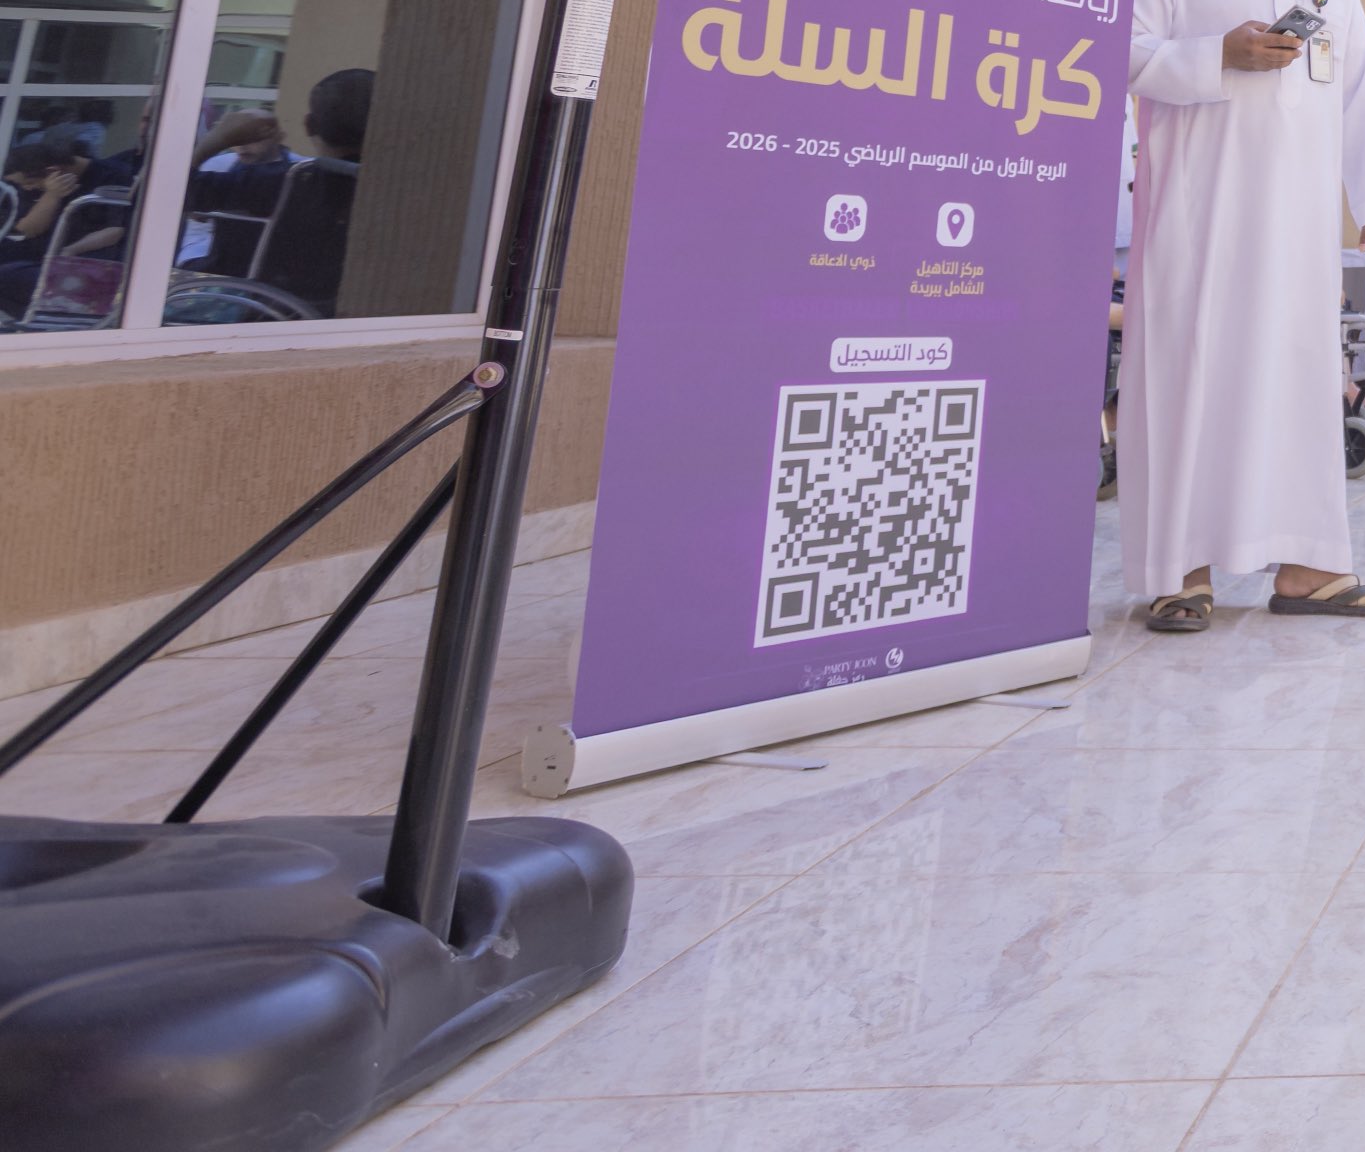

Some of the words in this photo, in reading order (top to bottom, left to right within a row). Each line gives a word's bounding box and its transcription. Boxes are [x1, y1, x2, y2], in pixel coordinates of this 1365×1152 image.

[976, 29, 1101, 135] كرة
[727, 132, 777, 151] 2026
[795, 138, 840, 157] 2025
[844, 145, 905, 167] الرياضي
[909, 153, 968, 171] الموسم
[972, 157, 993, 175] من
[997, 157, 1033, 177] الأول
[1036, 163, 1066, 182] الربع
[960, 262, 983, 278] مركز
[910, 281, 942, 297] ببريدة
[945, 280, 984, 296] الشامل
[838, 344, 911, 367] التسجيل
[916, 343, 948, 365] كود
